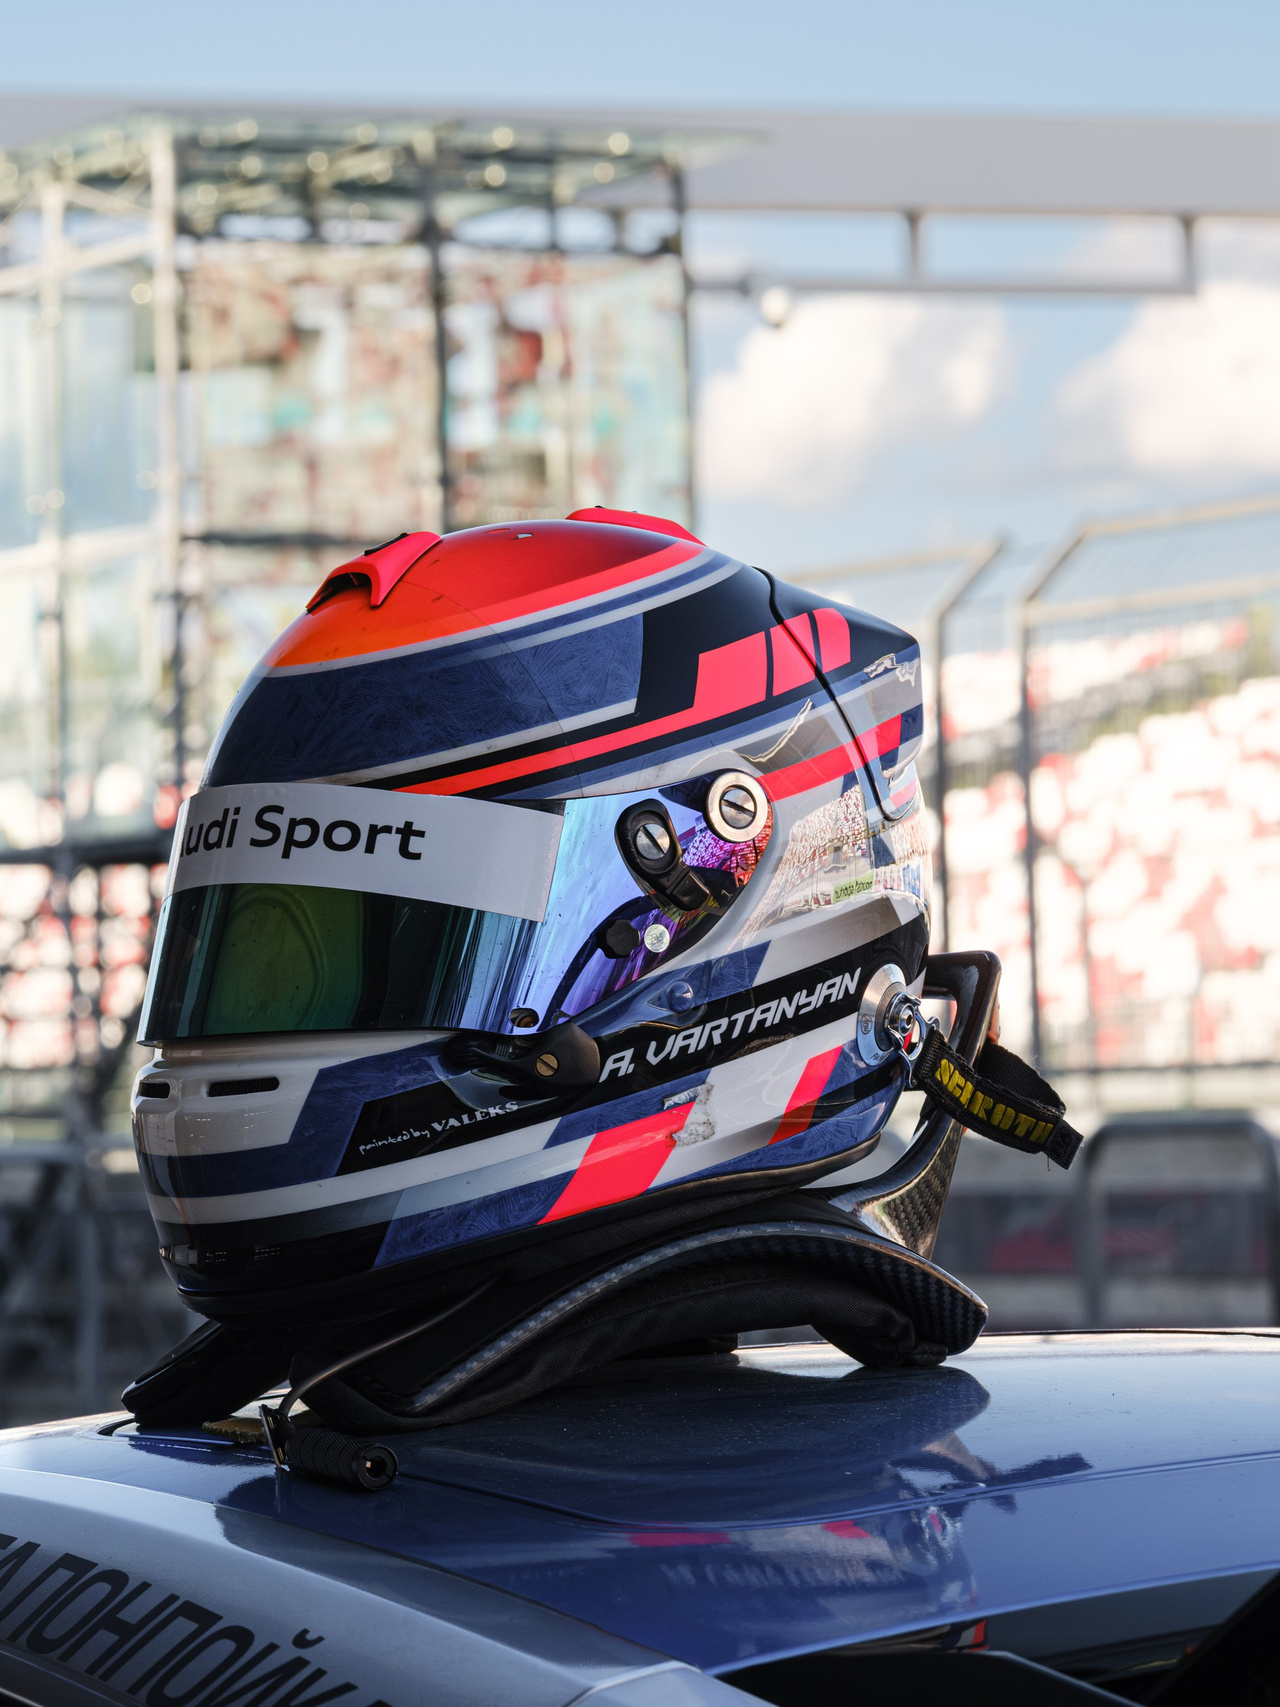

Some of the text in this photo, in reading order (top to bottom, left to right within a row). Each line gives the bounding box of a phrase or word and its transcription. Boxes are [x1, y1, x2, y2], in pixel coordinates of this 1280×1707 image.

[180, 805, 426, 861] udi Sport
[599, 967, 862, 1083] A. VARTANYAN
[359, 1101, 519, 1155] painted by VALEKS
[934, 1058, 1054, 1145] SCHROTH
